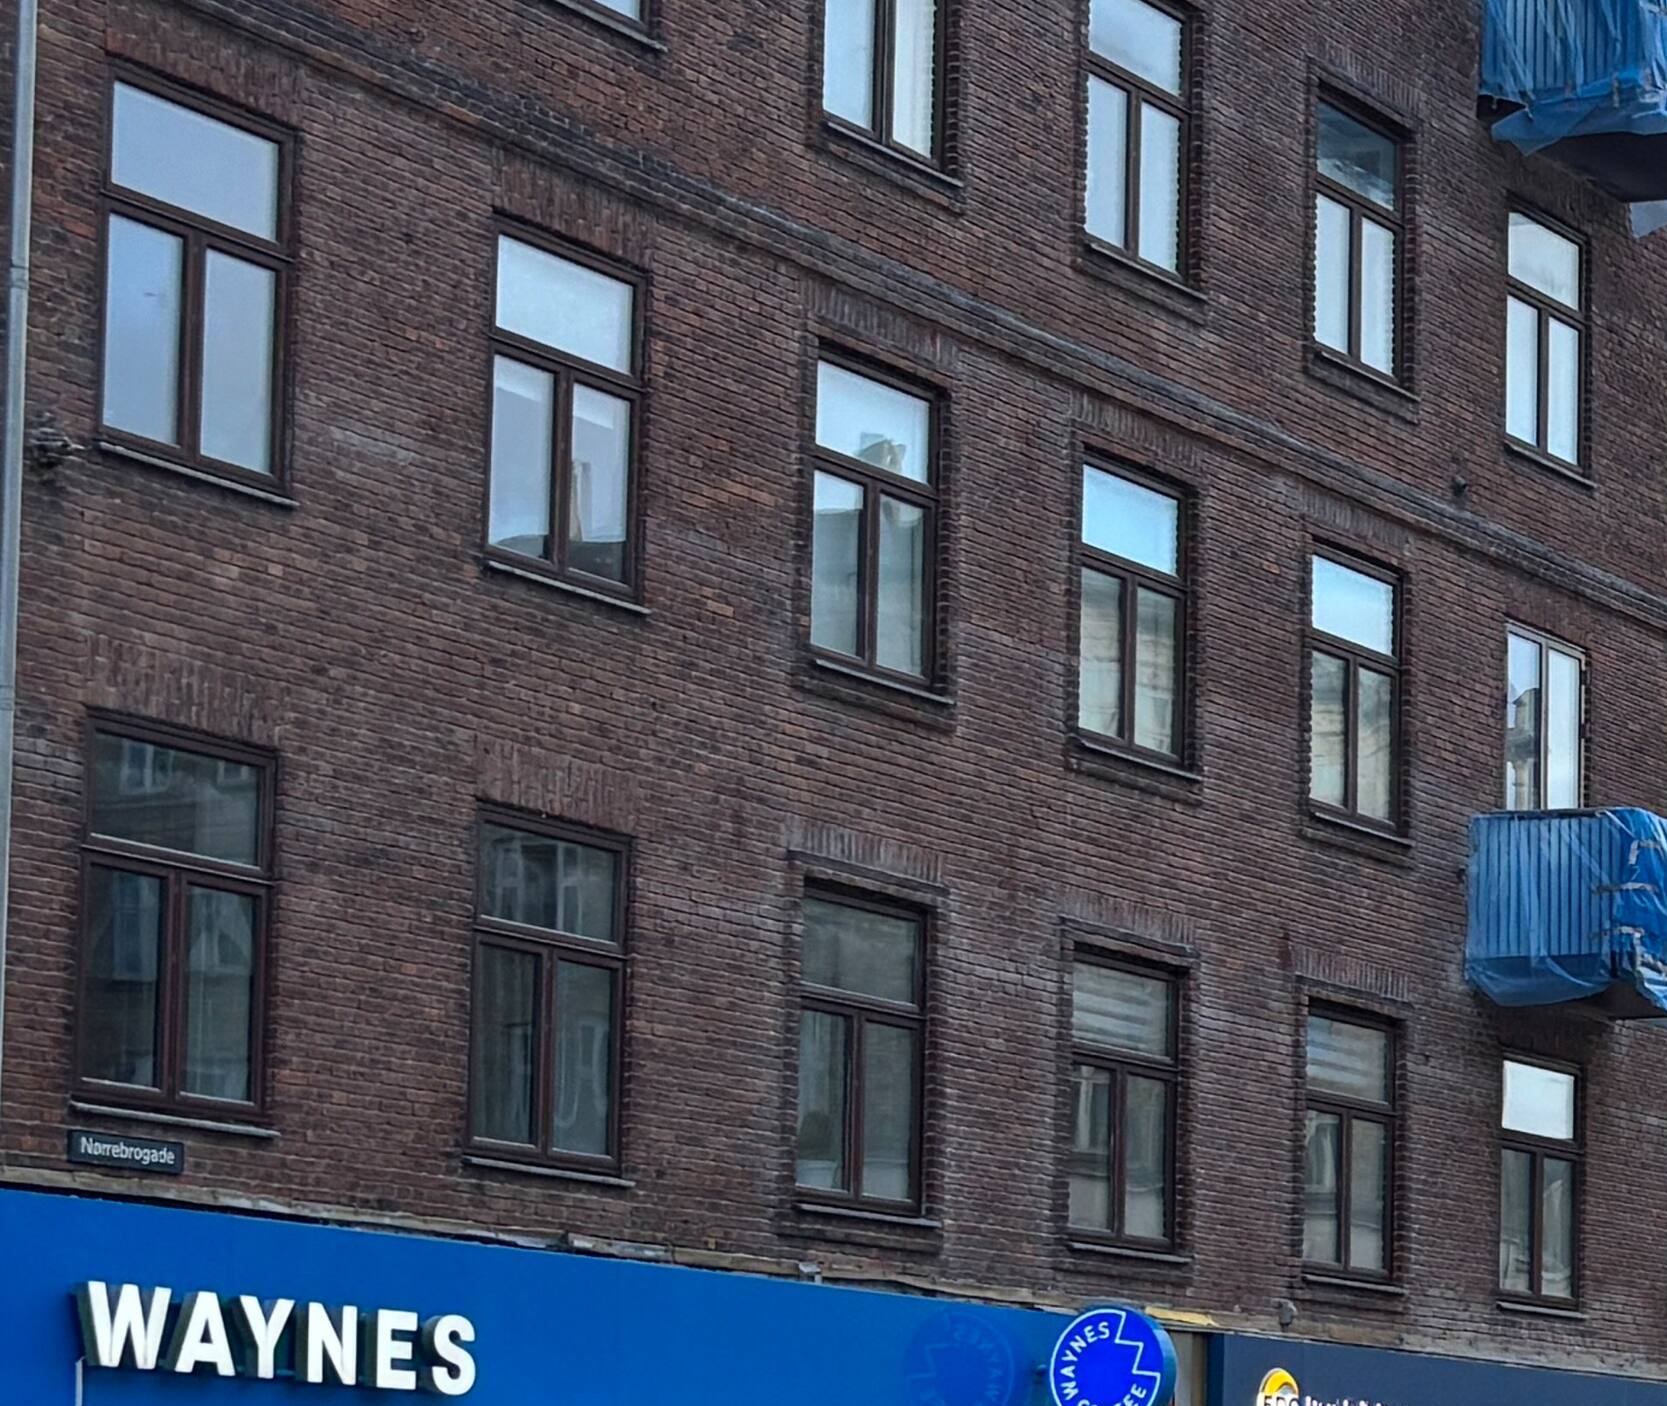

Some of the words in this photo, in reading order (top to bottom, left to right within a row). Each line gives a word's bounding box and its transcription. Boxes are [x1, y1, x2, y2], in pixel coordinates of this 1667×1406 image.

[80, 1136, 175, 1165] Nørrebrogade
[87, 1280, 477, 1396] WAYNES
[1060, 1320, 1110, 1400] WAYNES
